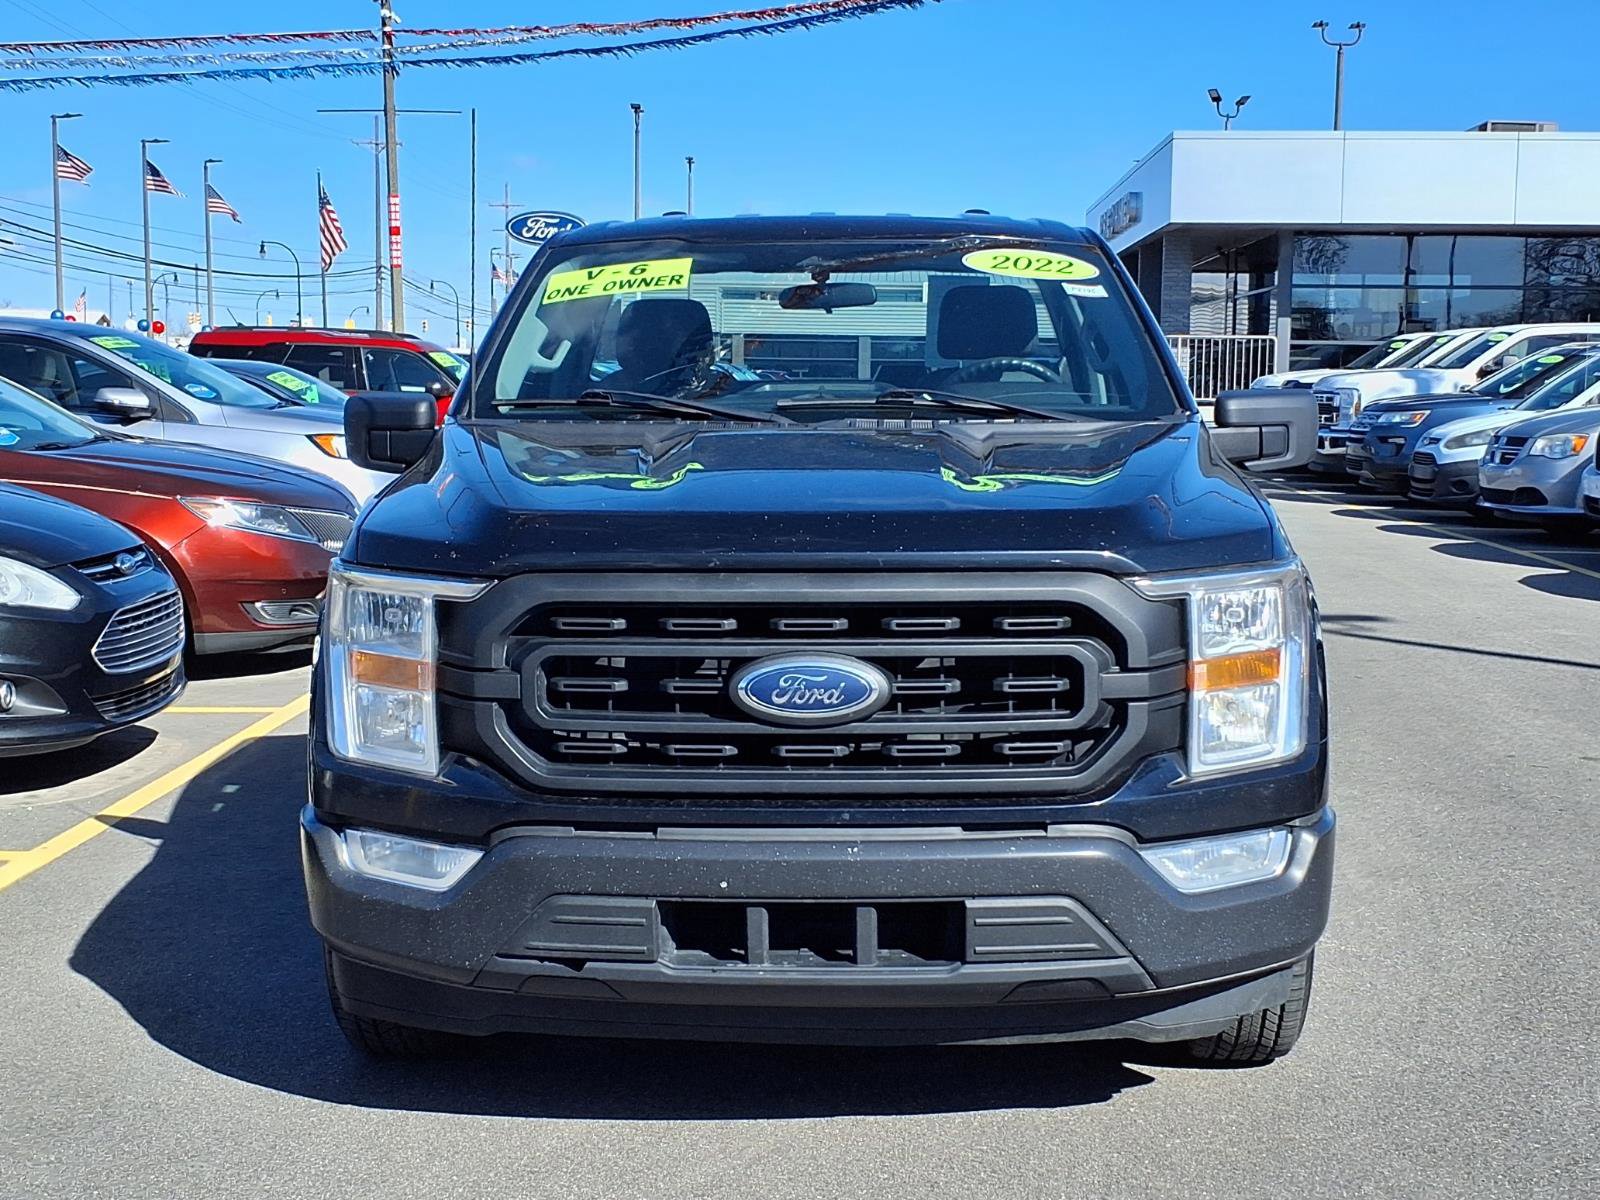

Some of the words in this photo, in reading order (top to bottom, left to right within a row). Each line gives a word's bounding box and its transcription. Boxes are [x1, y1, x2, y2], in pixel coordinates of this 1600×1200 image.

[991, 255, 1074, 274] 2022
[546, 283, 593, 300] ONE
[602, 274, 684, 292] OWNER
[771, 673, 845, 705] Ford
